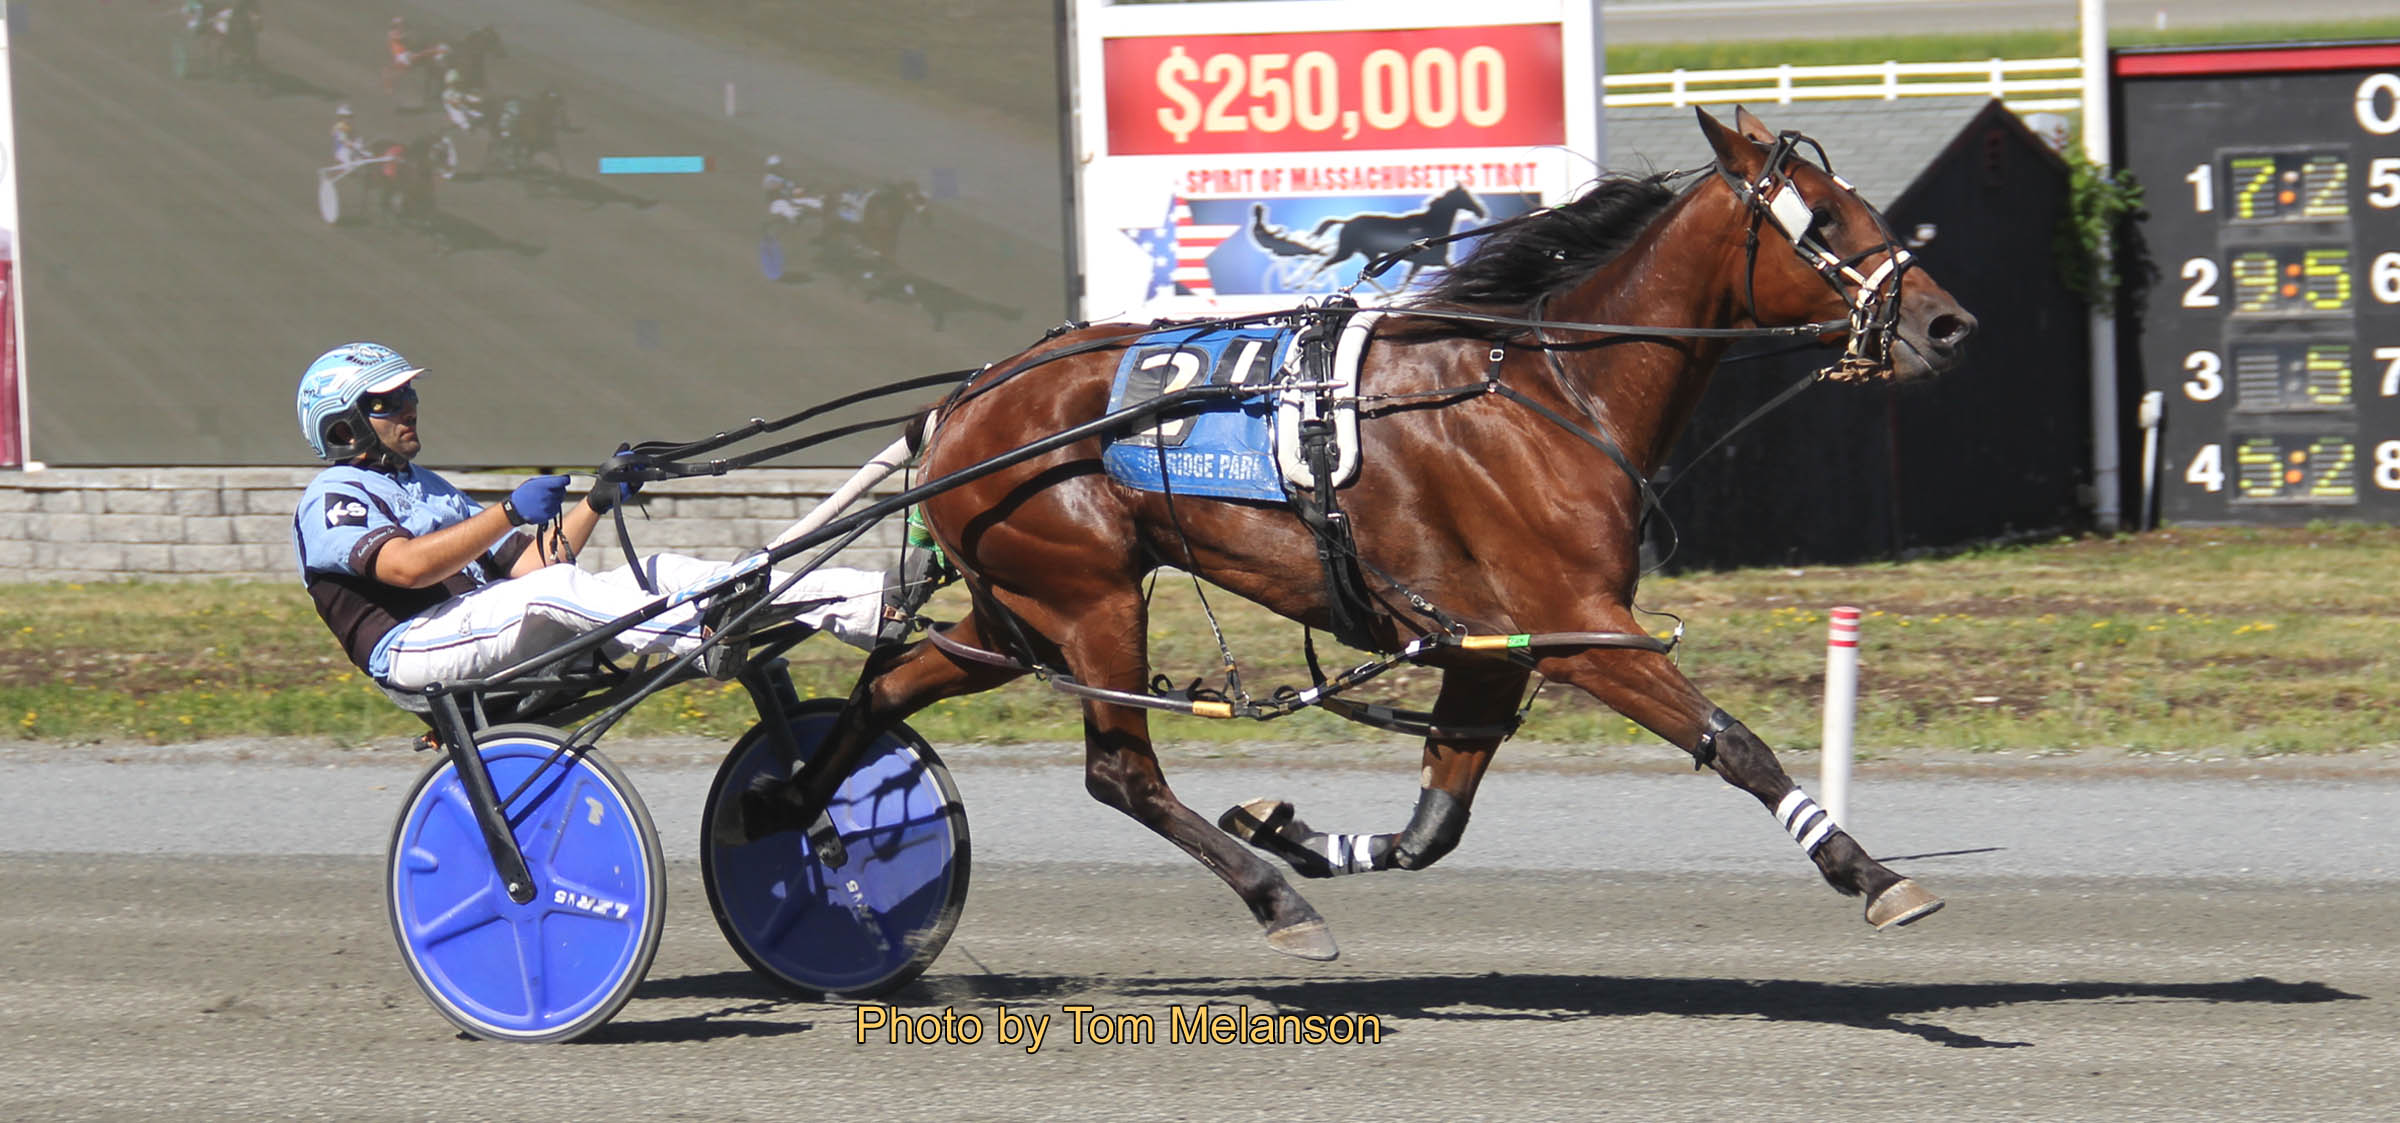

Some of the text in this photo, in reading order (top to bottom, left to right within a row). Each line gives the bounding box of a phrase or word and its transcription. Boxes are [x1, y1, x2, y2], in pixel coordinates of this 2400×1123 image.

[1156, 46, 1507, 143] $250,000
[1187, 161, 1538, 193] SPIRIT OF MASSACHUSETTS TROT
[2187, 164, 2214, 212] 1
[2367, 158, 2400, 208] 5
[2181, 257, 2219, 307] 2
[2370, 252, 2400, 303] 6
[2183, 350, 2224, 401] 3
[2372, 346, 2400, 397] 7
[2185, 443, 2225, 493] 4
[2373, 439, 2400, 491] 8
[326, 500, 367, 526] KS
